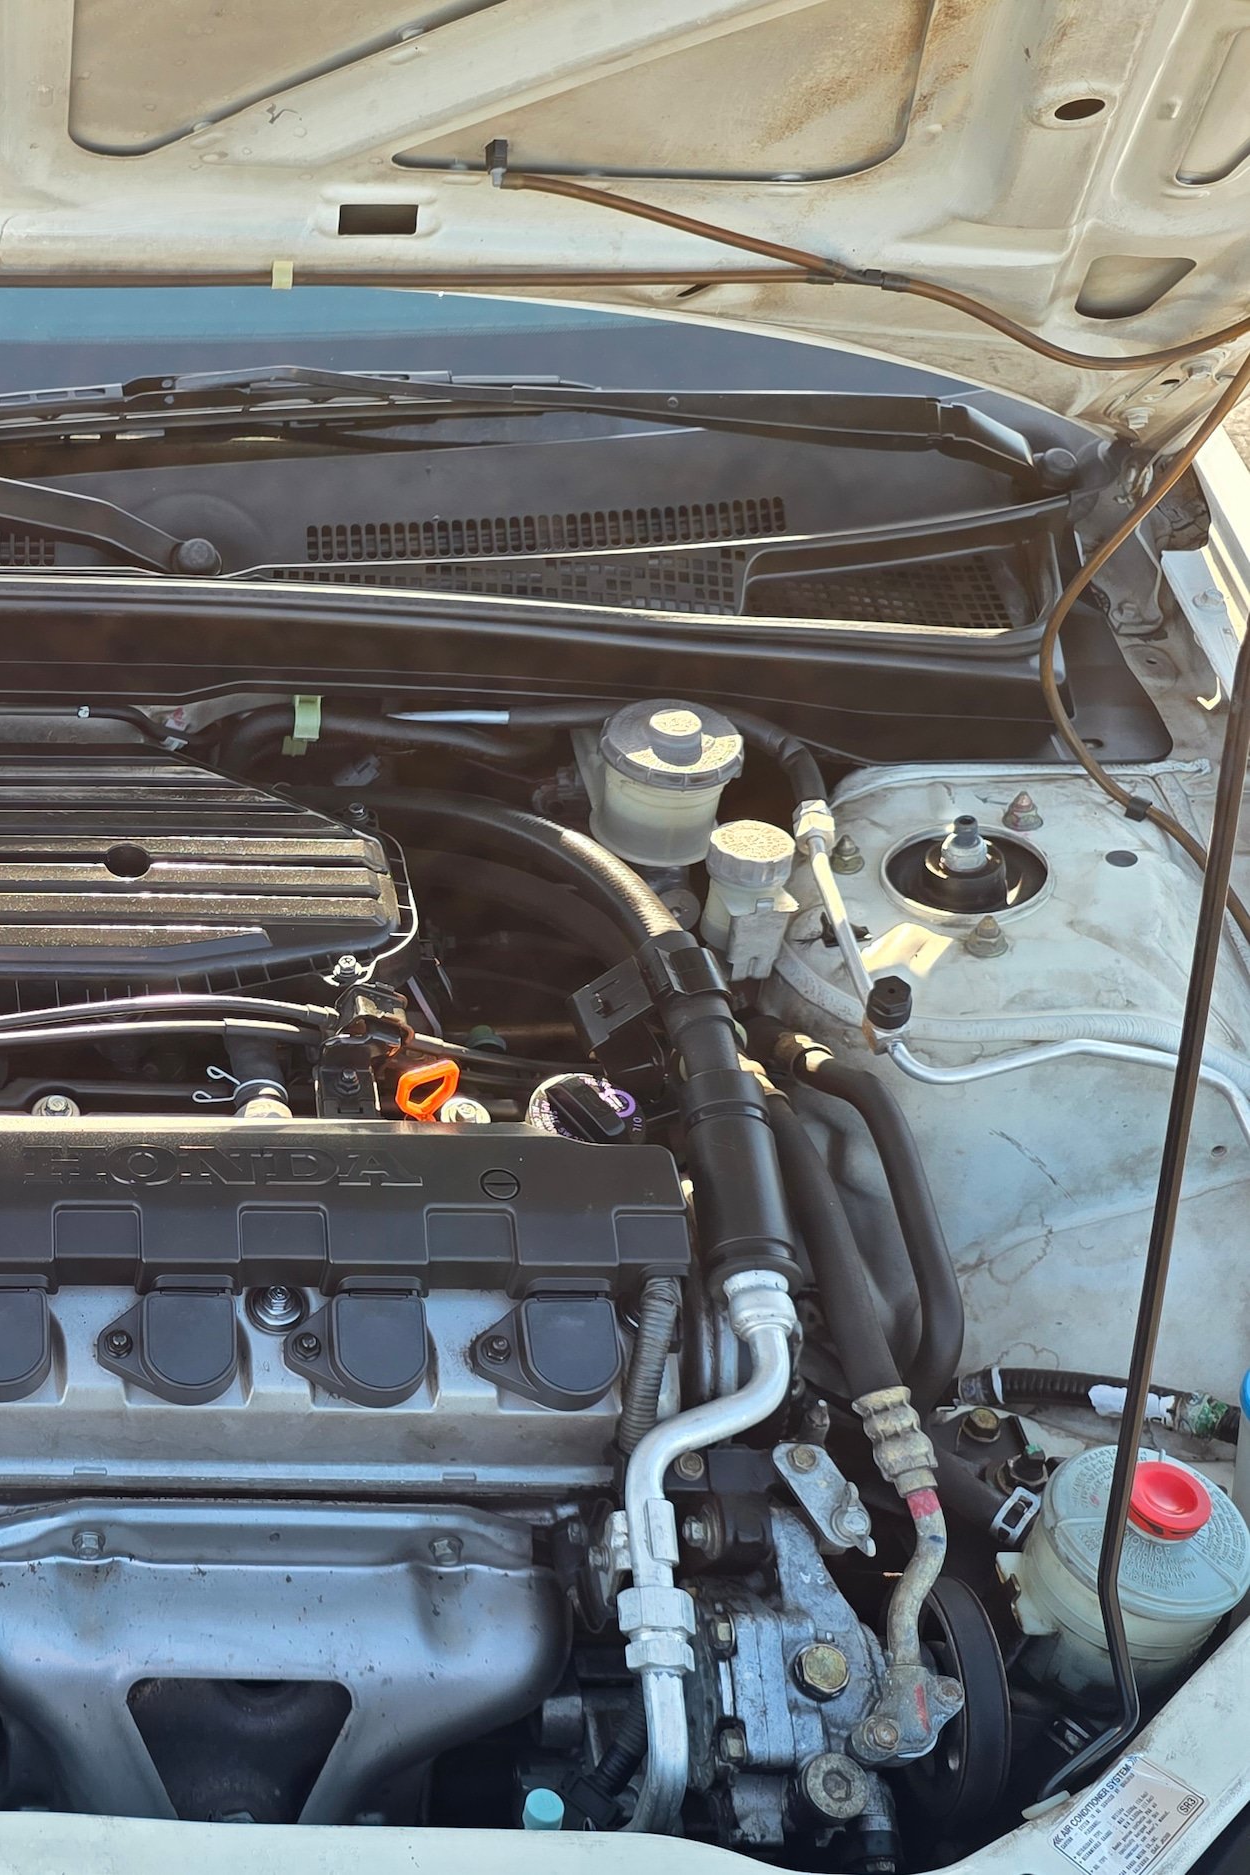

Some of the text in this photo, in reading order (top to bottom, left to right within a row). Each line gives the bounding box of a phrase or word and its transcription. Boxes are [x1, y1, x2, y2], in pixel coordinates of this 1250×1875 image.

[632, 1116, 642, 1131] OIL
[22, 1143, 424, 1187] HONDA
[1060, 1824, 1072, 1836] AIR
[1070, 1787, 1109, 1826] CONDITIONER
[1106, 1764, 1131, 1789] SYSTEM
[1180, 1797, 1195, 1812] SR3
